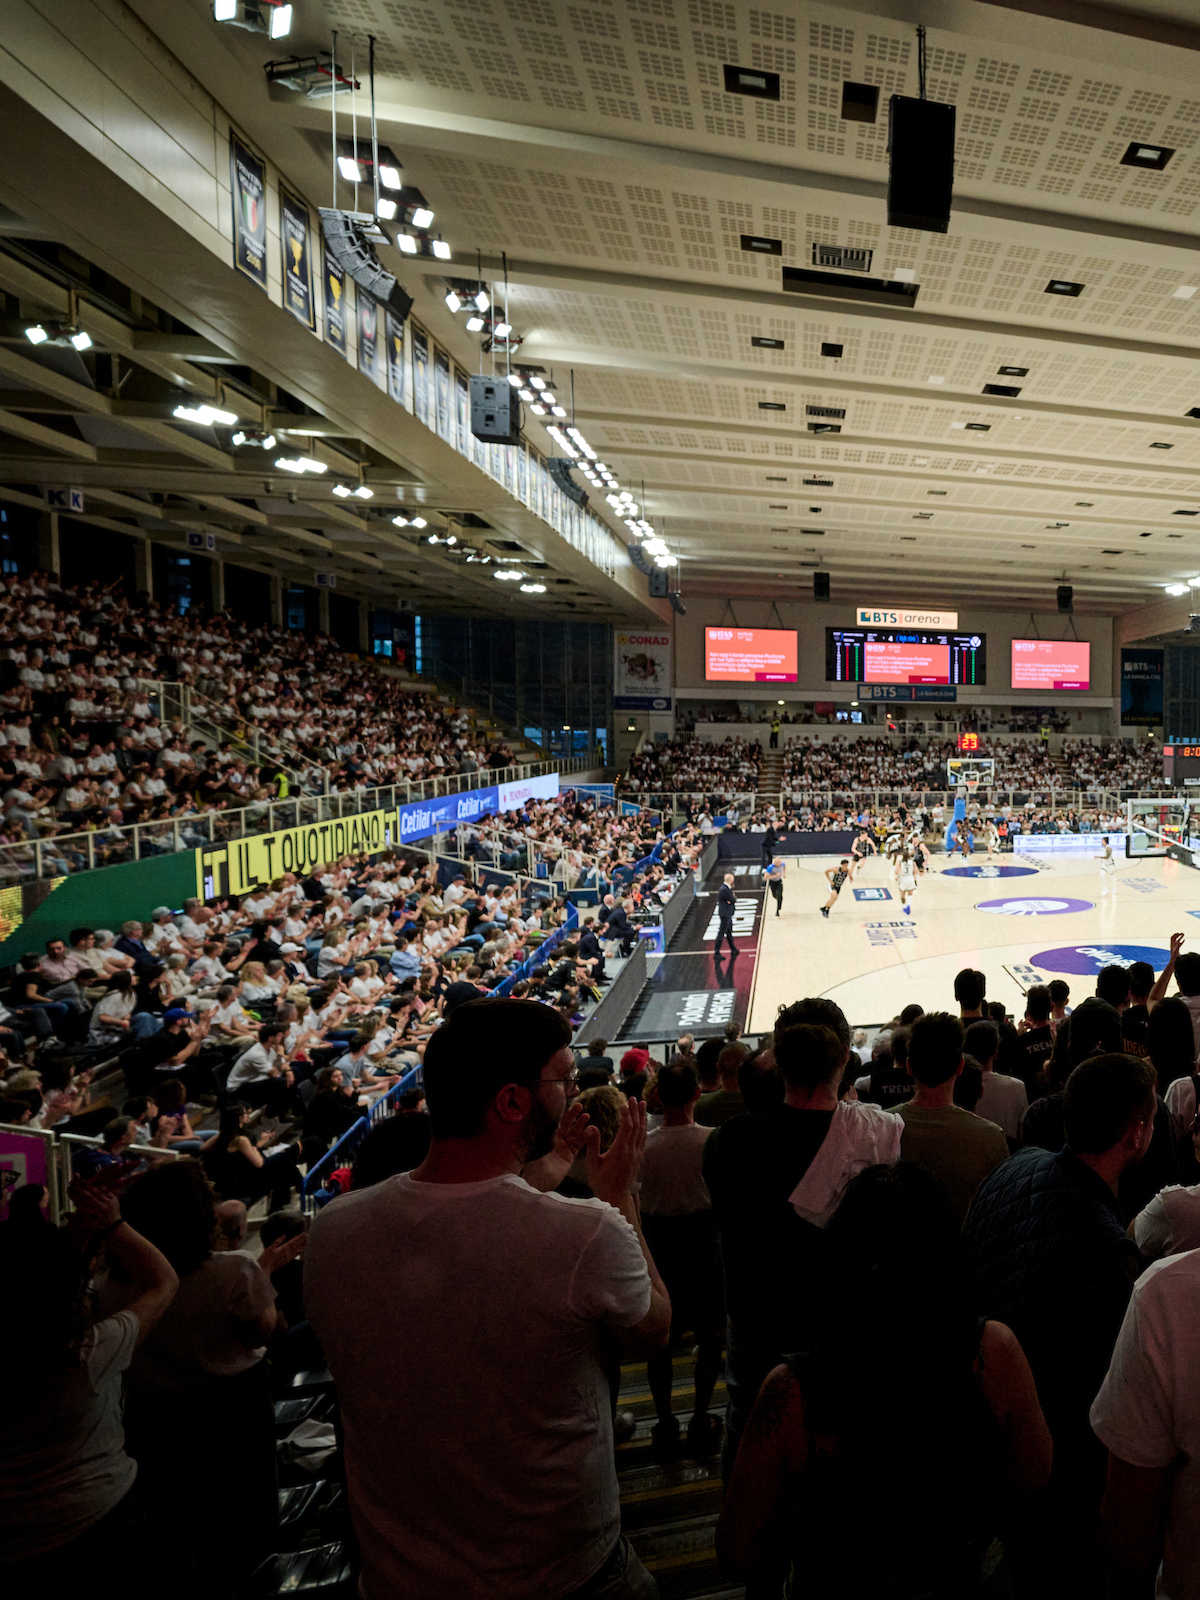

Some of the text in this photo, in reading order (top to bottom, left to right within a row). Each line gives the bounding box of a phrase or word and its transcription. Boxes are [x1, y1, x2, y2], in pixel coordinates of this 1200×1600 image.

[48, 490, 65, 505] K
[72, 492, 80, 508] K
[189, 534, 202, 545] D
[317, 575, 326, 583] E
[873, 612, 897, 624] BTS
[905, 614, 940, 624] arena
[629, 636, 669, 645] CONAD
[1133, 662, 1148, 670] BTS
[873, 686, 896, 697] BTS
[962, 738, 978, 749] 23
[457, 797, 480, 819] Cetilar
[401, 808, 432, 835] Cetilar
[238, 815, 380, 889] IL T QUOTIDIANO
[1025, 1040, 1053, 1055] TREN
[881, 1084, 916, 1095] TRENT
